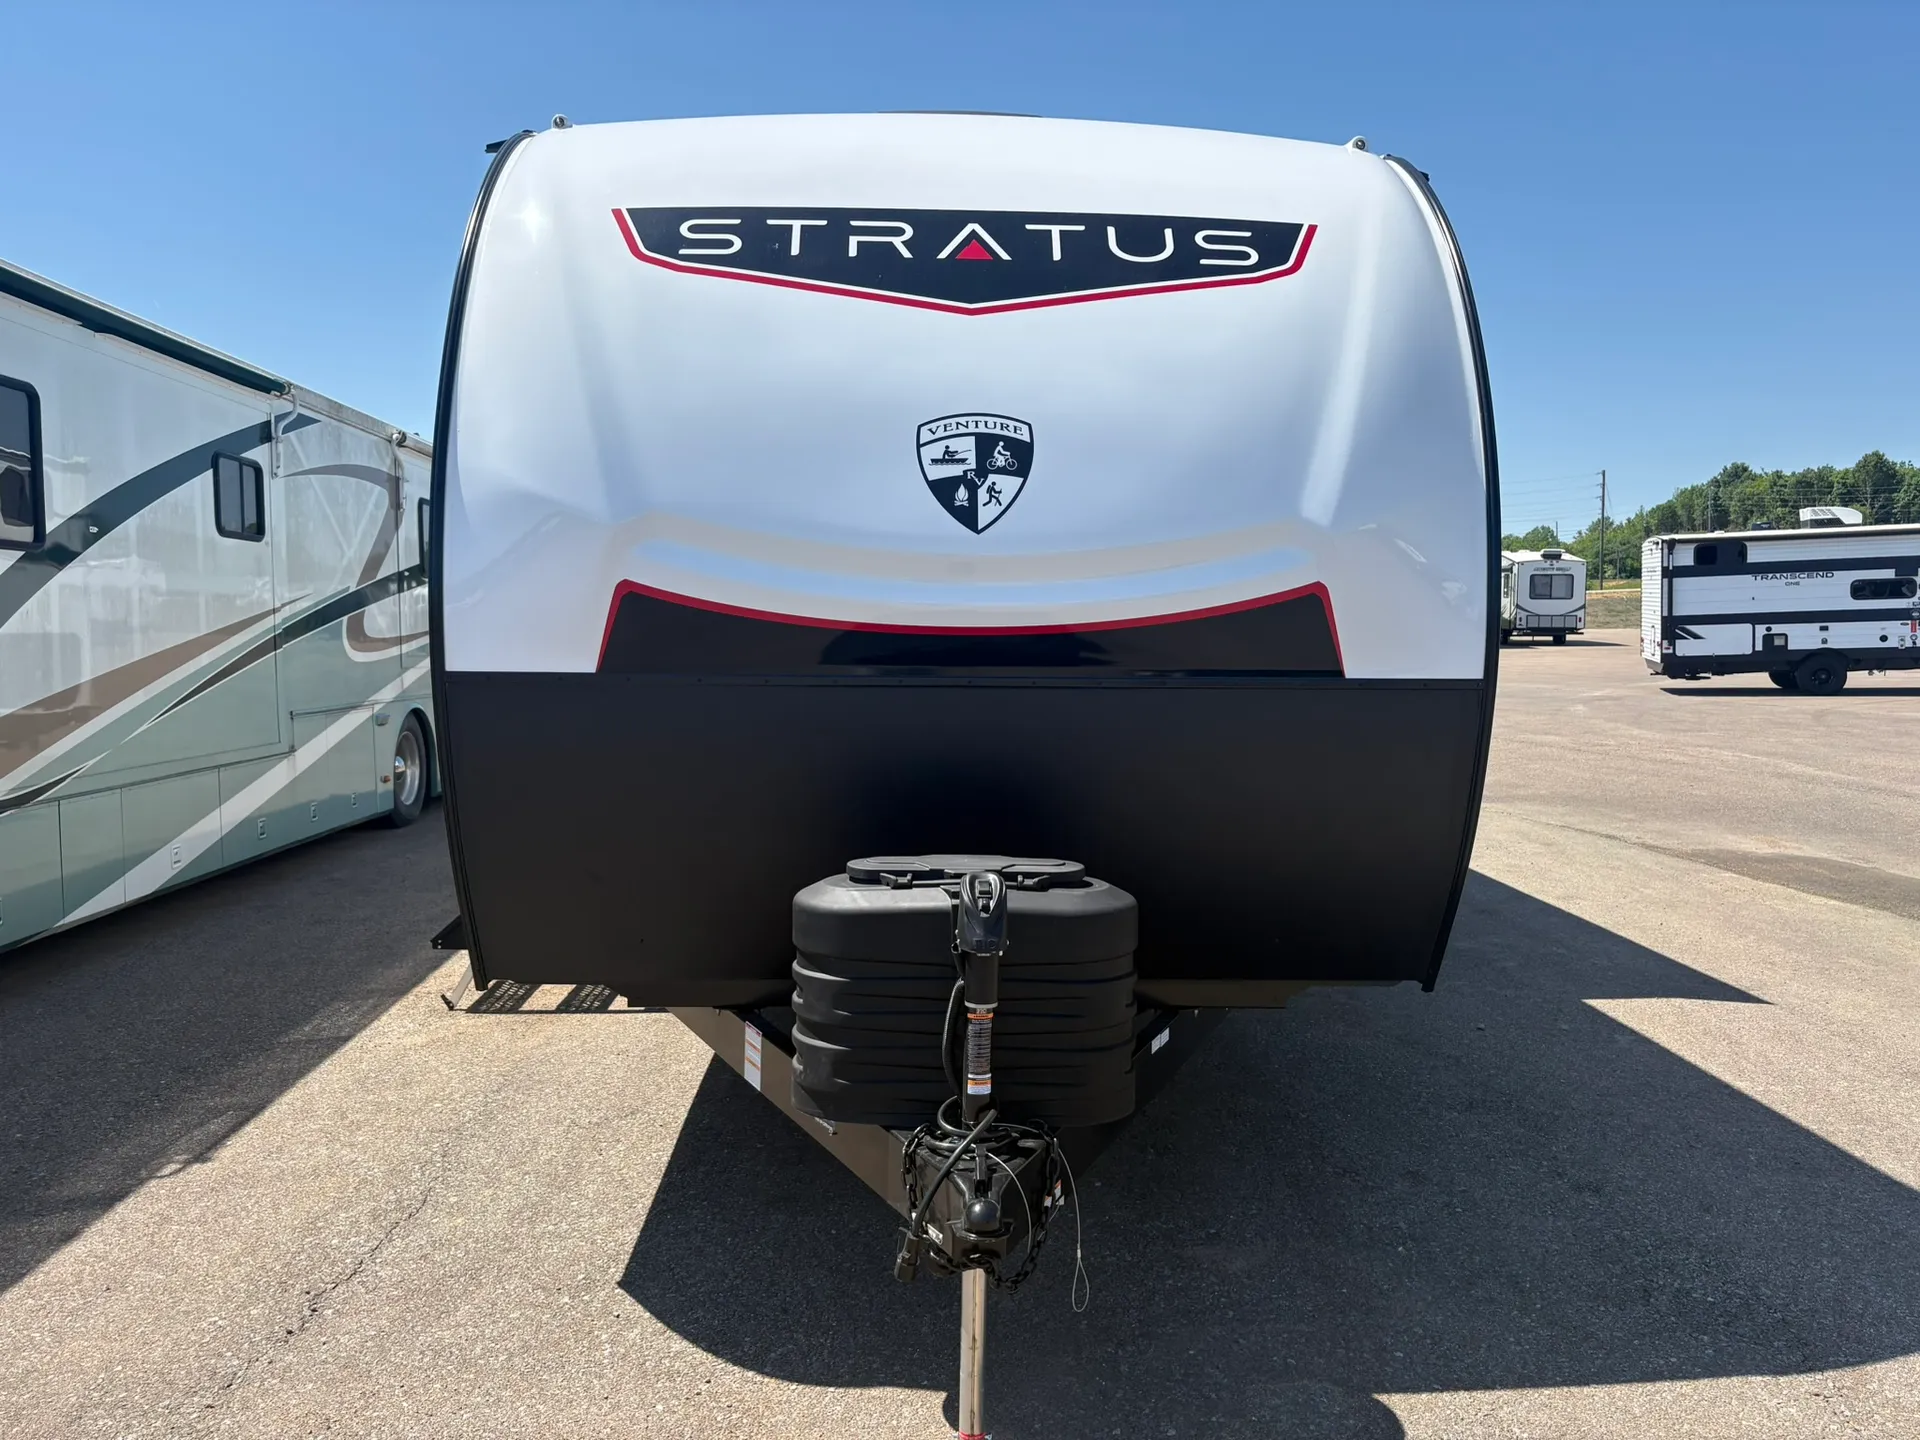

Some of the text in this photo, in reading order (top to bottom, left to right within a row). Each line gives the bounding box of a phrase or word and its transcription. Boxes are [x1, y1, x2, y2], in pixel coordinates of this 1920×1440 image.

[678, 218, 1260, 266] STRATUS
[927, 420, 1024, 436] VENTURE
[1751, 571, 1835, 581] TRANSCEND
